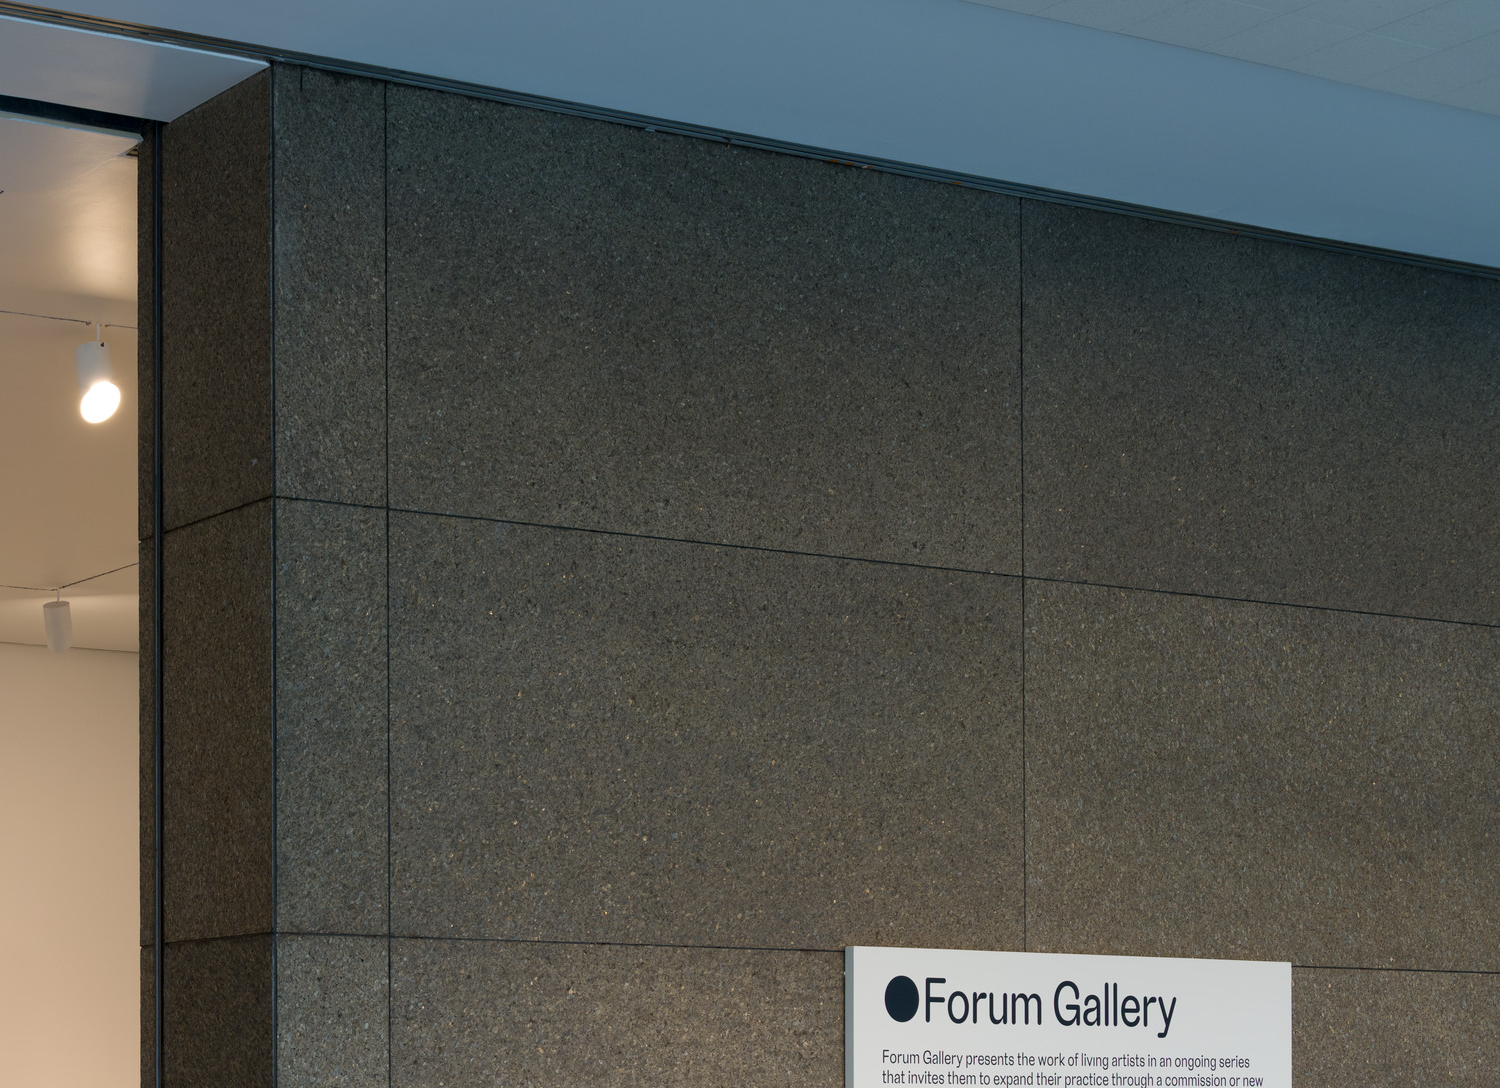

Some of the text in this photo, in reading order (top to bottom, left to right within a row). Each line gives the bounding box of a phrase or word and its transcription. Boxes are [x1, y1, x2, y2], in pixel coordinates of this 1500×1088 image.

[925, 977, 1177, 1039] Forum Gallery
[882, 1049, 1250, 1072] Forum Gallery presents the work of living artists in an ongoing series
[882, 1070, 905, 1084] that
[908, 1070, 945, 1085] invites
[947, 1071, 977, 1085] them
[979, 1072, 991, 1086] to
[993, 1072, 1034, 1088] expand
[1036, 1072, 1062, 1086] their
[1064, 1073, 1109, 1088] practice
[1156, 1076, 1163, 1087] a
[1165, 1073, 1227, 1087] commission
[1229, 1077, 1241, 1087] or
[1243, 1077, 1264, 1087] new
